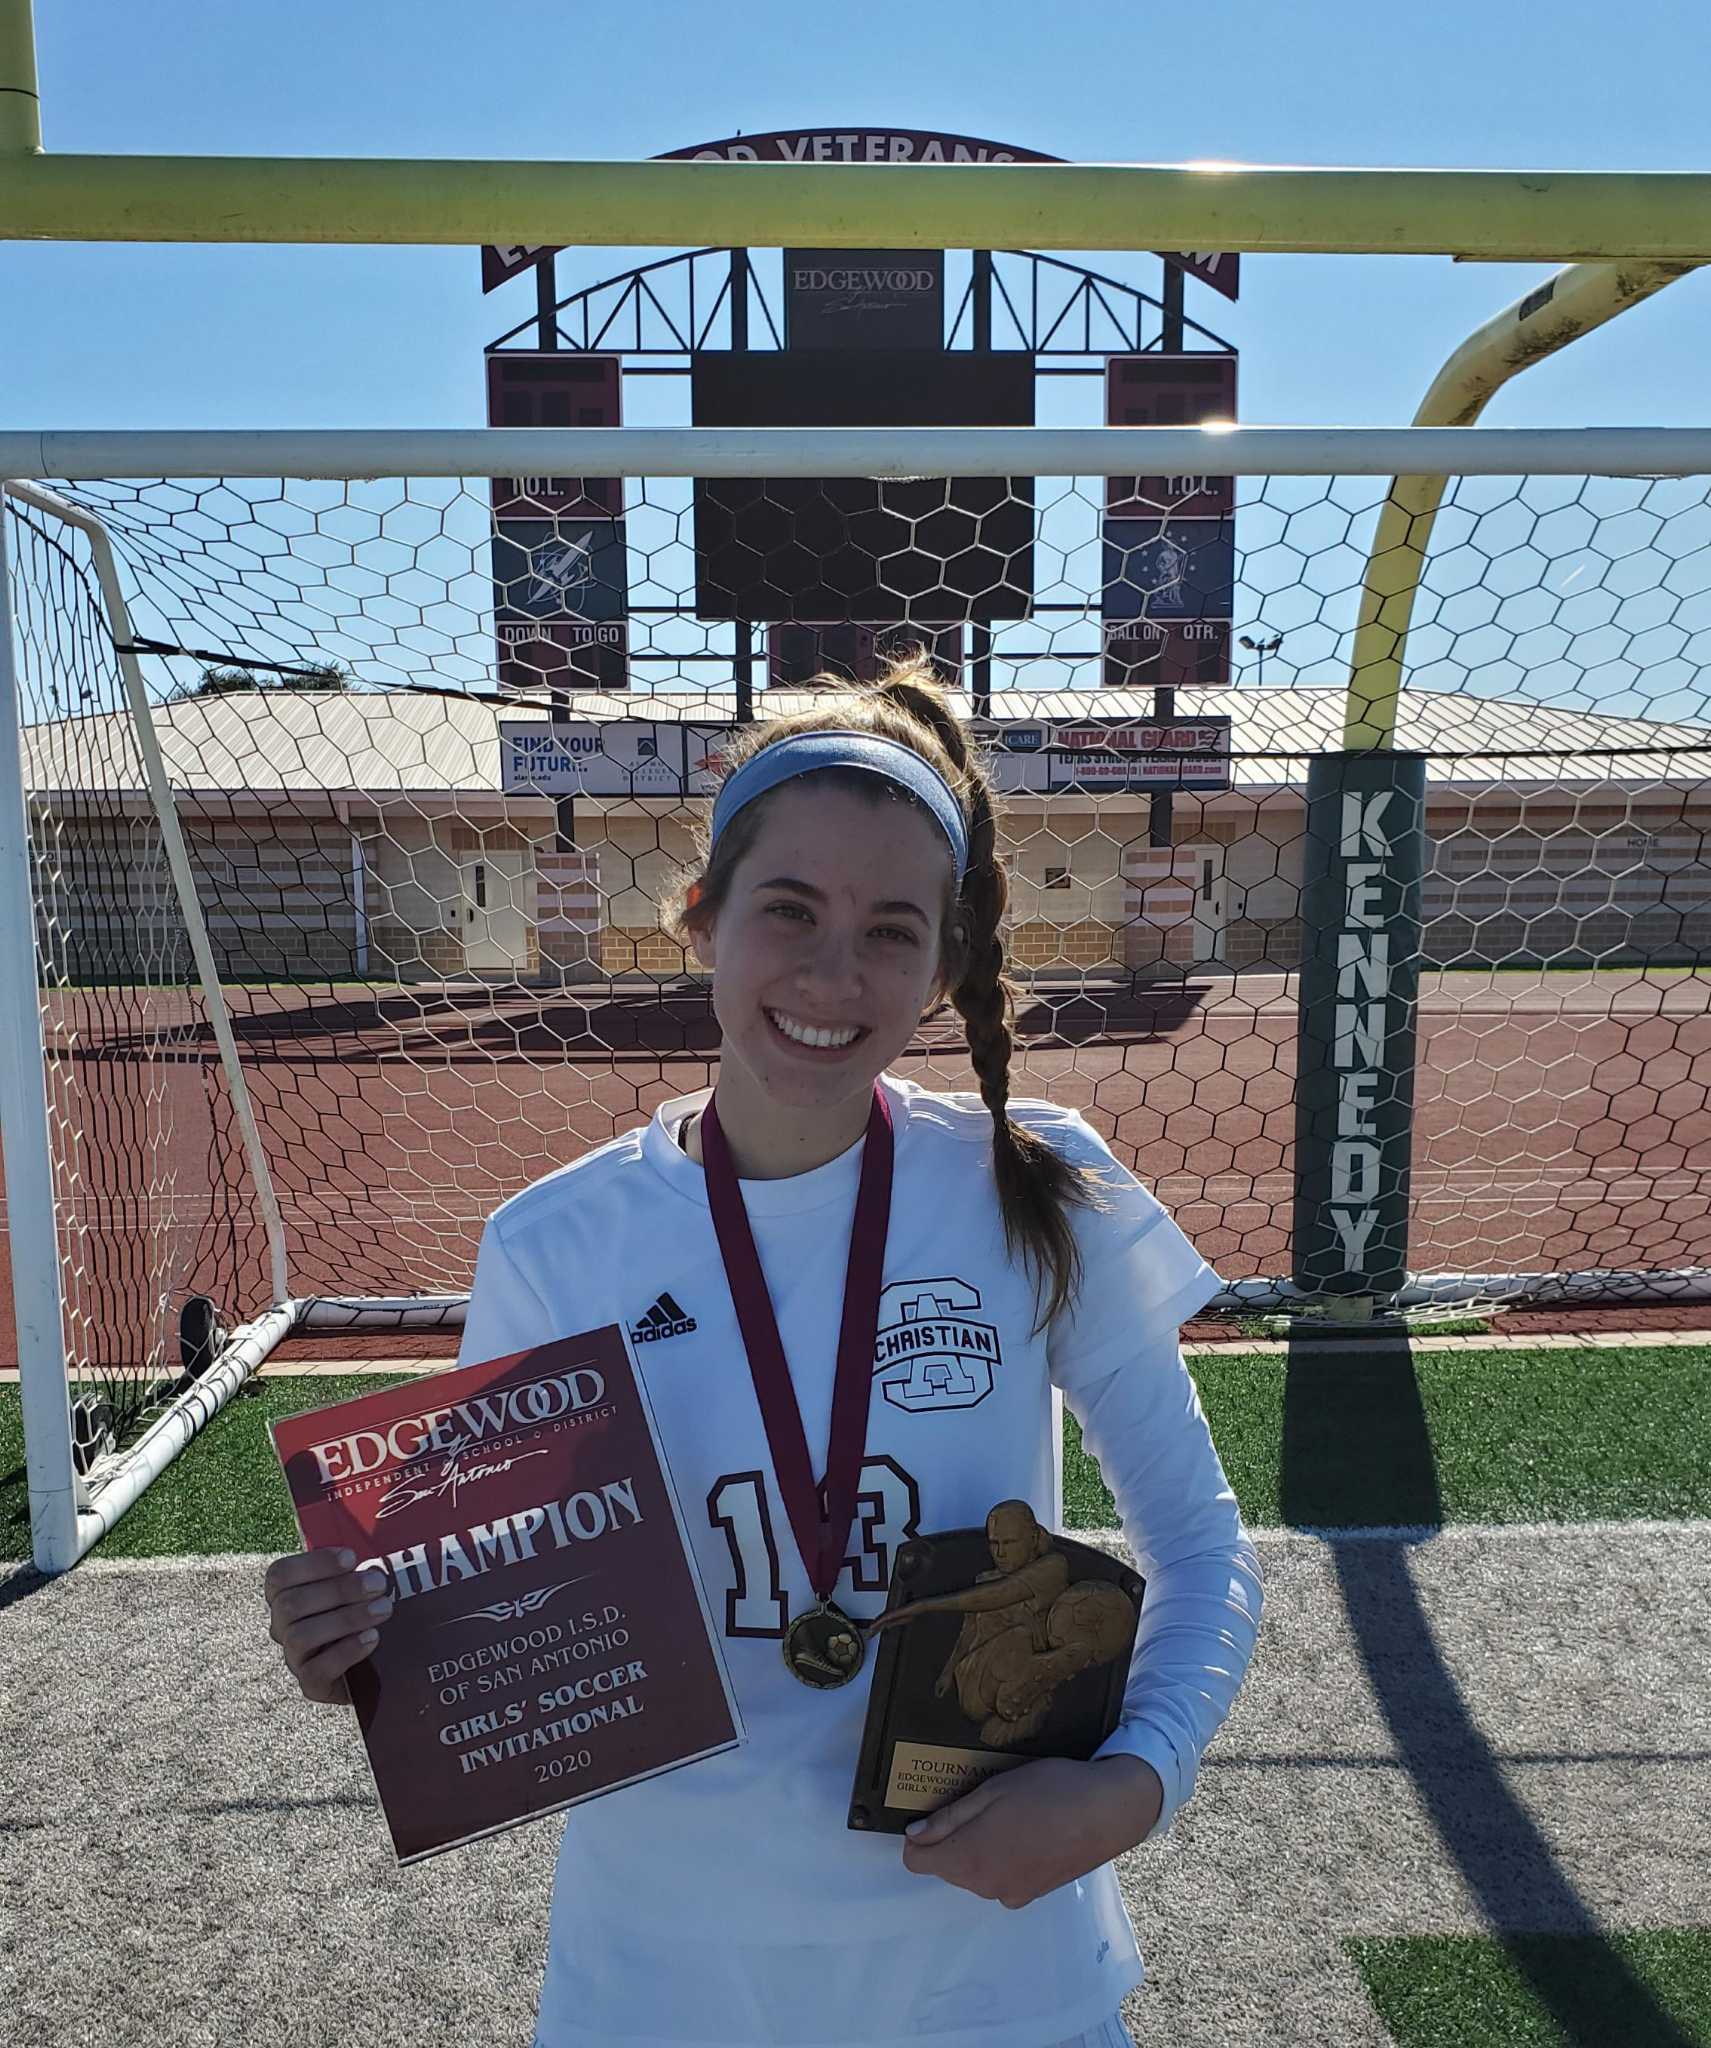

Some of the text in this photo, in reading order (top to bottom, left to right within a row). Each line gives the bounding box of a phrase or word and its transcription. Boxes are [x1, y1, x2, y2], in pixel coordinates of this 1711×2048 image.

[793, 270, 934, 291] EDGEWOOD
[505, 627, 619, 643] DOWN TO GO
[1143, 625, 1161, 640] ON
[1183, 625, 1219, 640] QTR.
[513, 736, 605, 753] FIND YOUR
[1057, 730, 1197, 749] NATIONAL GUARD
[1331, 791, 1394, 1272] KENNEDY
[630, 1317, 698, 1345] adidas
[874, 1325, 992, 1363] CHRISTIAN
[309, 1368, 606, 1485] EDGEWOOD
[327, 1404, 618, 1503] INDEPENDENT SCHOOL DISTRICT
[706, 1454, 922, 1639] 13
[427, 1606, 627, 1683] EDGEWOOD I.S.D.
[439, 1628, 630, 1705] OF SAN ANTONIO
[439, 1660, 649, 1746] GIRLS' SOCCER
[458, 1694, 645, 1774] INVITATIONAL
[533, 1749, 592, 1784] 2020
